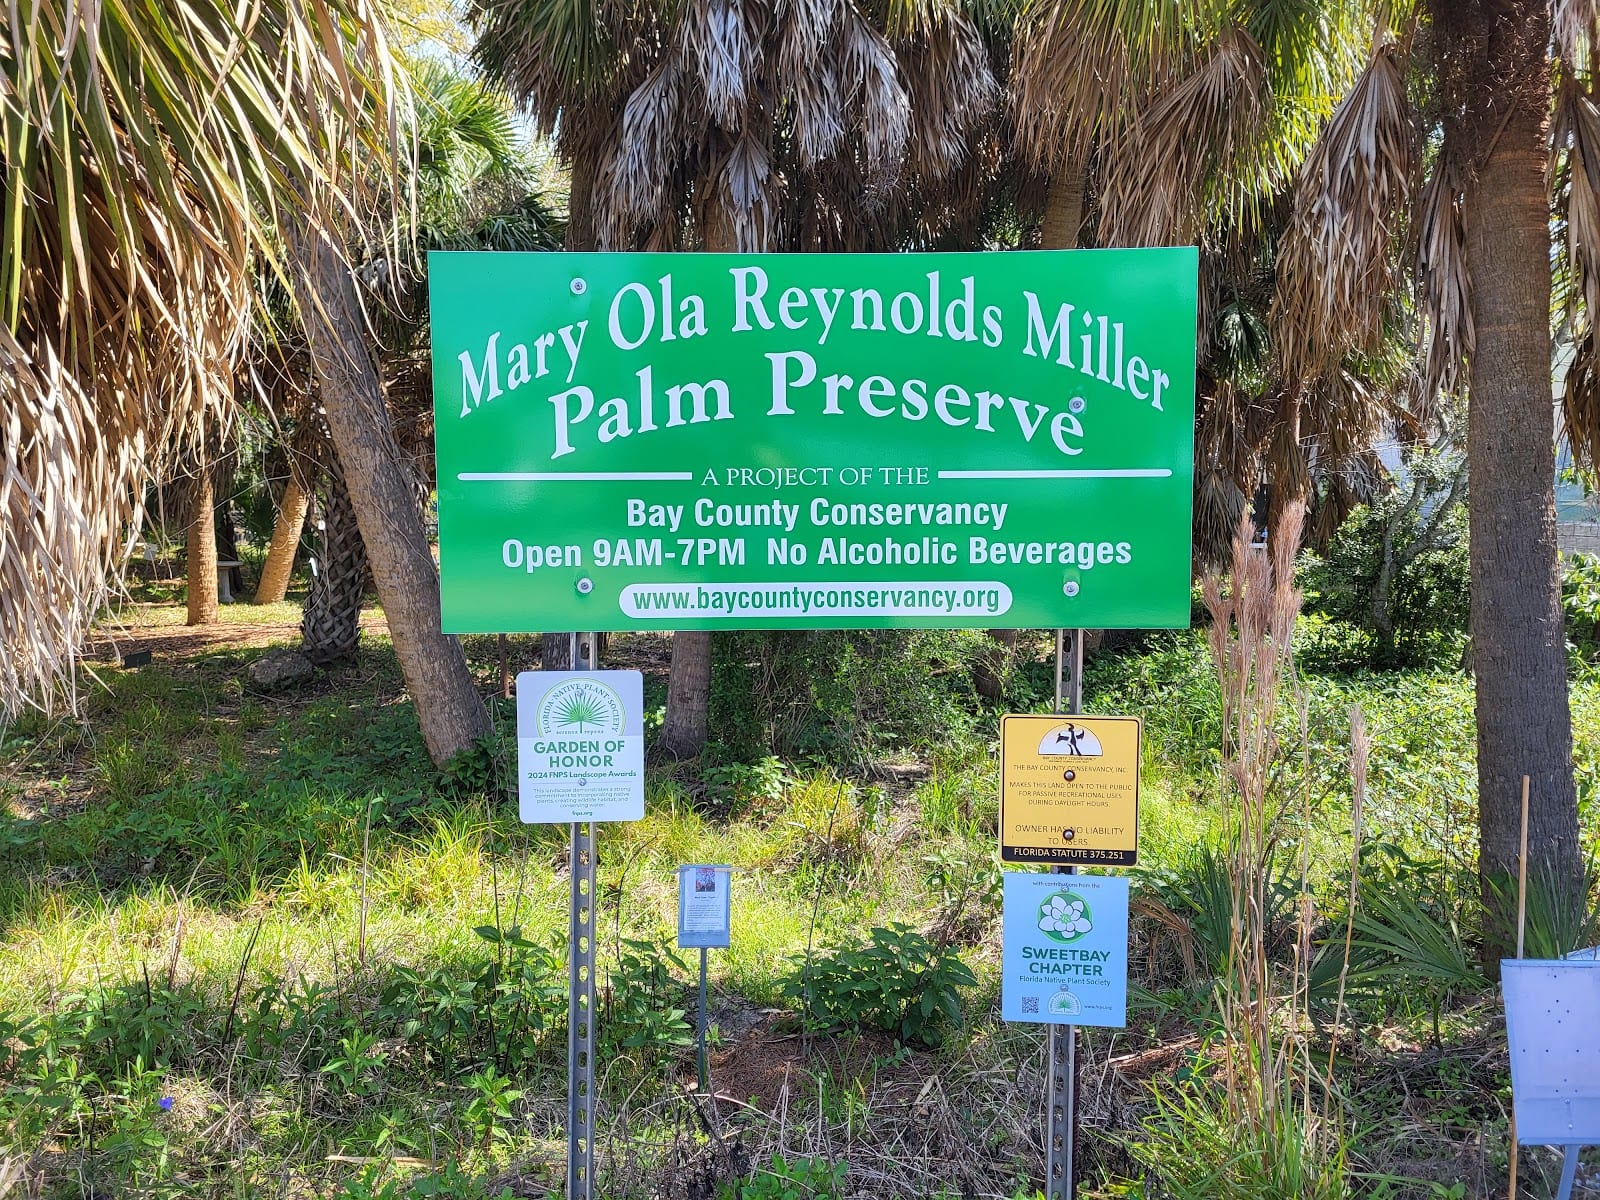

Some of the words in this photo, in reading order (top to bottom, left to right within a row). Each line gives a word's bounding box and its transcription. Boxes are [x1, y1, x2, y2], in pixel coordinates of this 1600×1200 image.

[457, 319, 589, 419] Mary
[608, 273, 709, 351] Ola
[728, 265, 1003, 348] Reynolds
[1022, 290, 1170, 412] Miller
[548, 364, 734, 460] Palm
[764, 350, 1084, 456] Preserve
[701, 467, 720, 486] A
[726, 467, 833, 490] PROJECT
[839, 467, 873, 486] OF
[878, 467, 930, 485] THE
[627, 498, 684, 533] Bay
[694, 498, 800, 532] County
[810, 498, 1008, 531] Conservancy
[502, 539, 582, 574] Open
[593, 538, 746, 567] 9AM-7PM
[767, 537, 808, 566] No
[817, 537, 958, 565] Alcoholic
[969, 537, 1132, 570] Beverages
[633, 587, 999, 613] www.baycountyconservancy.org
[543, 701, 554, 734] FLORIDA
[553, 683, 580, 700] NATIVE
[584, 684, 609, 699] PLANT
[608, 699, 619, 732] SOCIETY
[534, 740, 600, 754] GARDEN
[604, 740, 625, 753] OF
[549, 755, 614, 768] HONOR
[549, 771, 568, 779] FNPS
[569, 771, 607, 779] Landscape
[1058, 791, 1105, 799] RECREATIONAL
[1015, 824, 1048, 833] OWNER
[1085, 827, 1124, 835] LIABILITY
[1048, 837, 1059, 845] TO
[1014, 847, 1050, 857] FLORIDA
[1051, 848, 1088, 858] STATUTE
[1090, 850, 1124, 860] 375.251
[1022, 946, 1111, 962] SWEETBAY
[1029, 962, 1103, 977] CHAPTER
[1019, 975, 1043, 983] Florida
[1044, 976, 1066, 984] Native
[1067, 977, 1085, 985] Plant
[1086, 978, 1111, 987] Society
